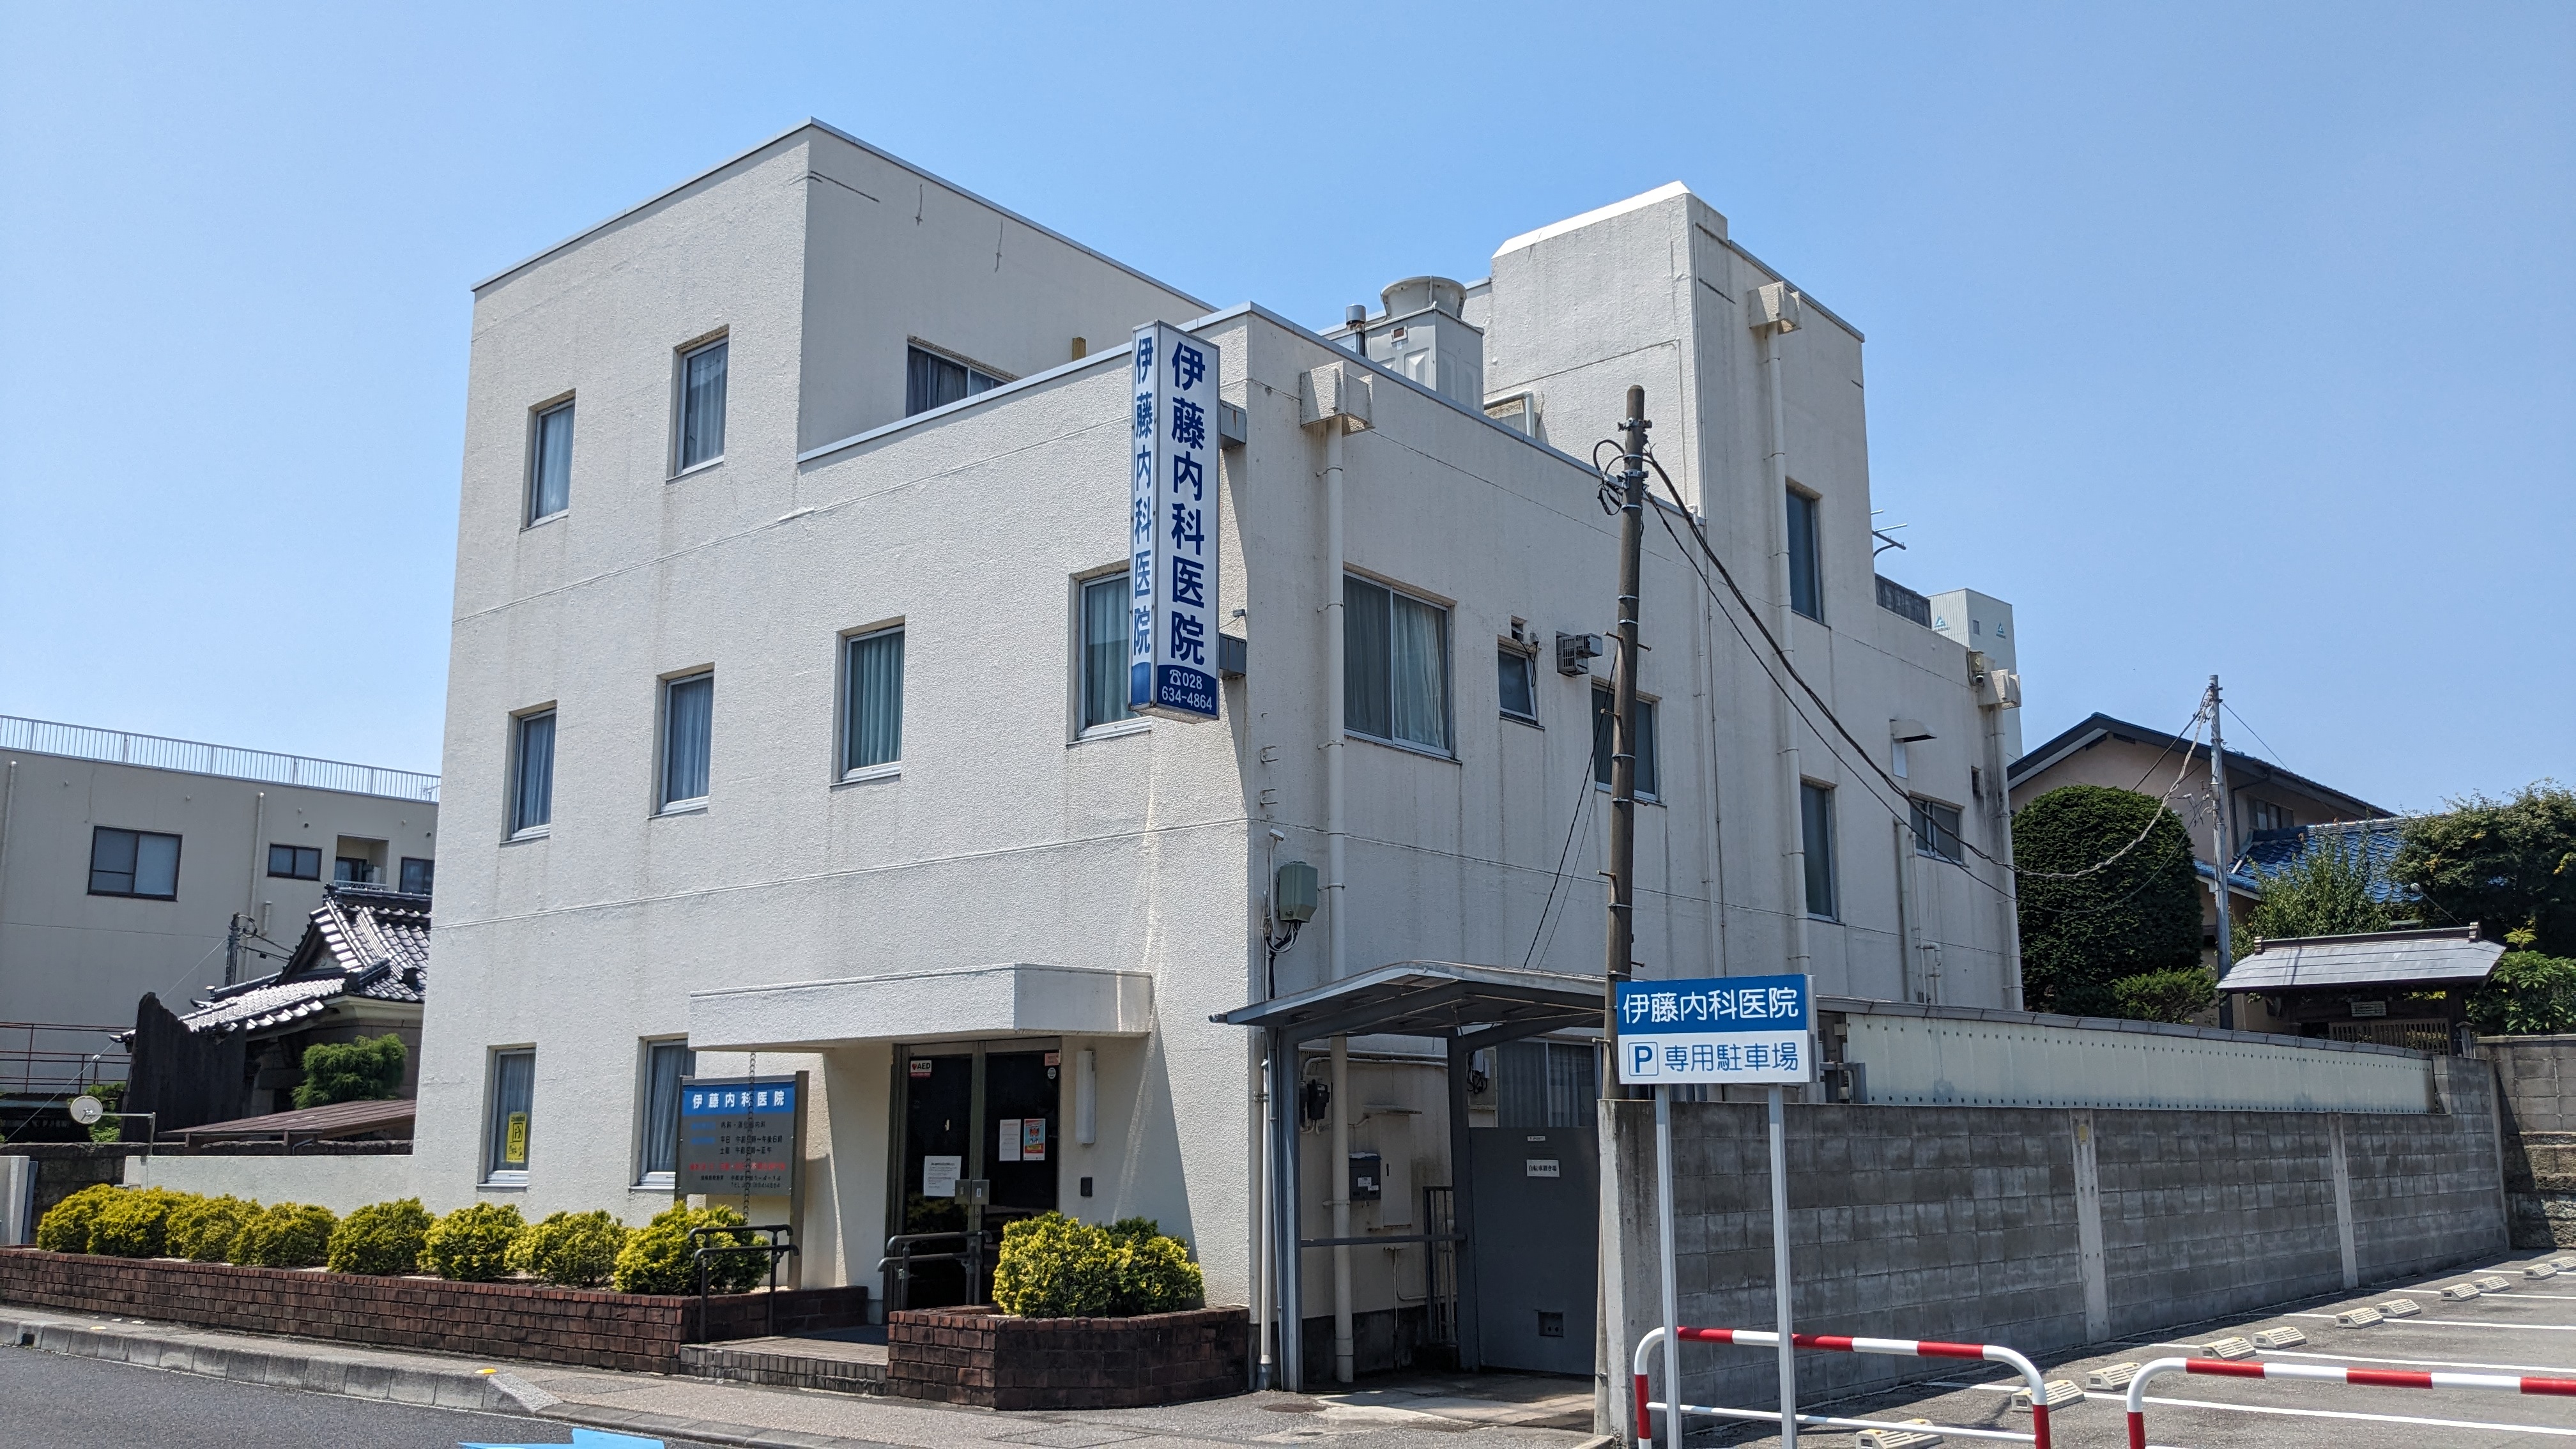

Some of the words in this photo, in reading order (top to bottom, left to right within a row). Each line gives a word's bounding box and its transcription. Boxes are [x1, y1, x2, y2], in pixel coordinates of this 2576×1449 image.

[1133, 336, 1154, 656] 伊藤内科医院
[1171, 341, 1206, 666] 伊藤内科医院
[1182, 671, 1202, 690] 028
[1162, 686, 1213, 710] 634-4864
[1622, 986, 1798, 1024] 伊藤内科医院
[1634, 1045, 1653, 1073] P
[1664, 1041, 1798, 1072] 専用駐車場
[693, 1090, 785, 1109] 伊藤内科医院
